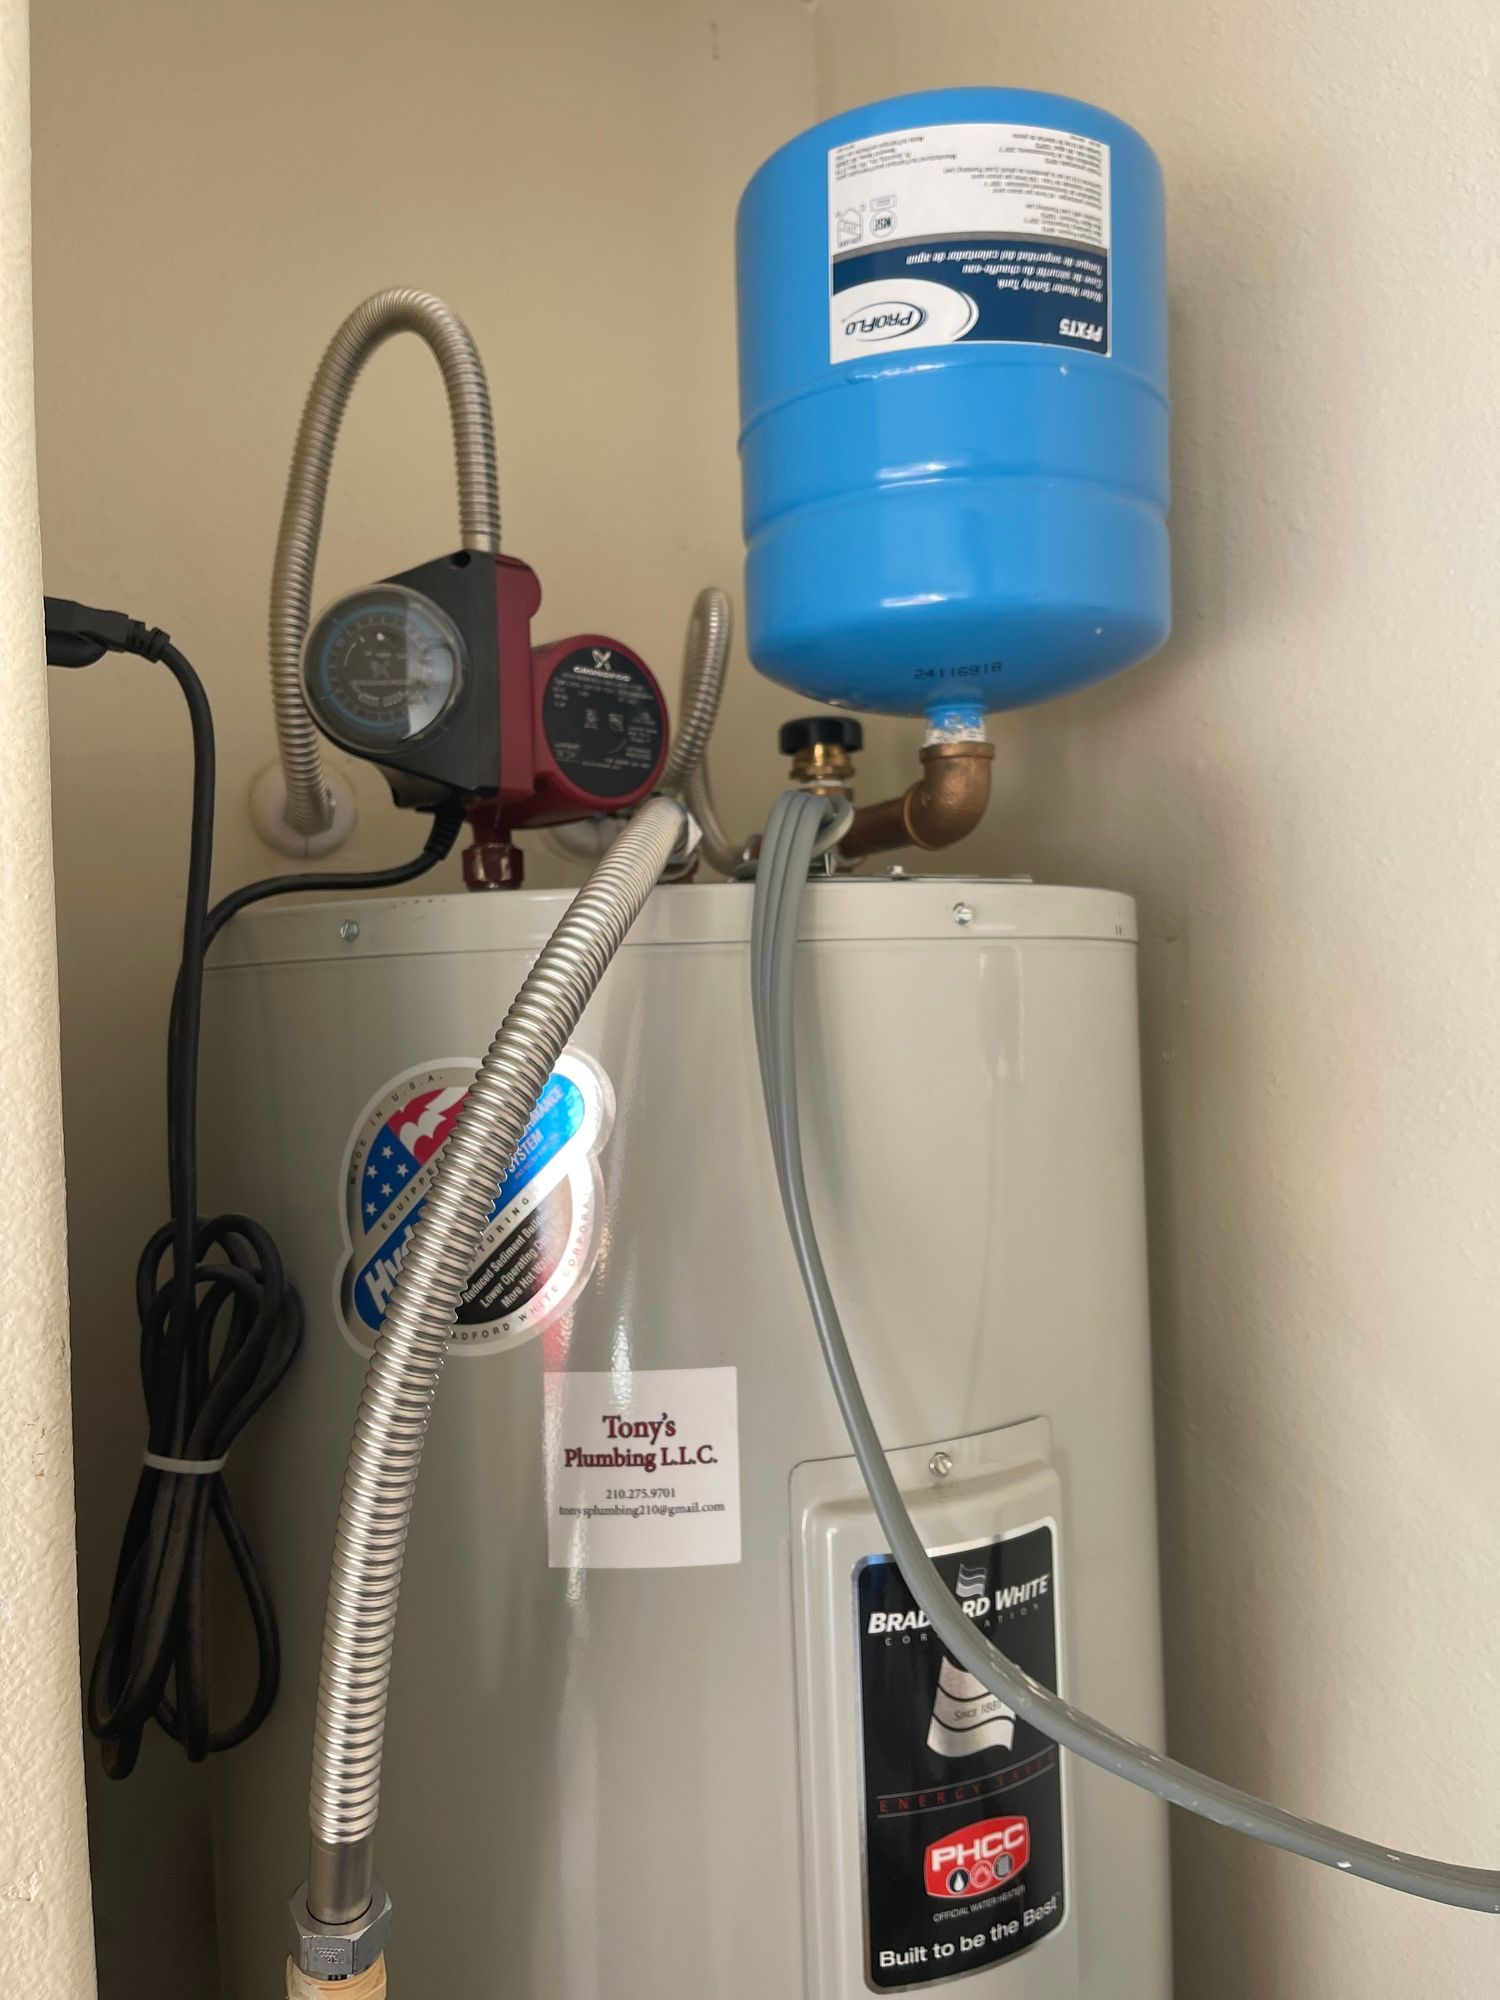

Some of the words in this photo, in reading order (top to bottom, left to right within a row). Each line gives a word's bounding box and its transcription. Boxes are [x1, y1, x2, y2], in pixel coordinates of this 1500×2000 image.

[1059, 318, 1103, 342] PFXT5
[913, 661, 1002, 680] 24116918
[370, 1111, 383, 1126] IN
[494, 1237, 525, 1274] Sediment
[479, 1283, 504, 1308] Lower
[501, 1249, 540, 1285] Operating
[500, 1286, 523, 1309] More
[519, 1271, 537, 1290] Hot
[602, 1413, 676, 1445] Tony's
[564, 1447, 656, 1473] Plumbing
[661, 1445, 718, 1465] L.L.C.
[606, 1488, 676, 1500] 210.275.9701
[559, 1502, 725, 1519] tonysplumbing210@gmail.com
[995, 1573, 1050, 1611] WHITE
[879, 1783, 982, 1813] ENERGY
[931, 1823, 1025, 1873] PHCC
[933, 1907, 969, 1922] OFFICIAL
[879, 1947, 928, 1968] Built
[932, 1940, 955, 1959] to
[960, 1932, 986, 1952] be
[989, 1921, 1019, 1942] the
[1023, 1896, 1058, 1927] Best
